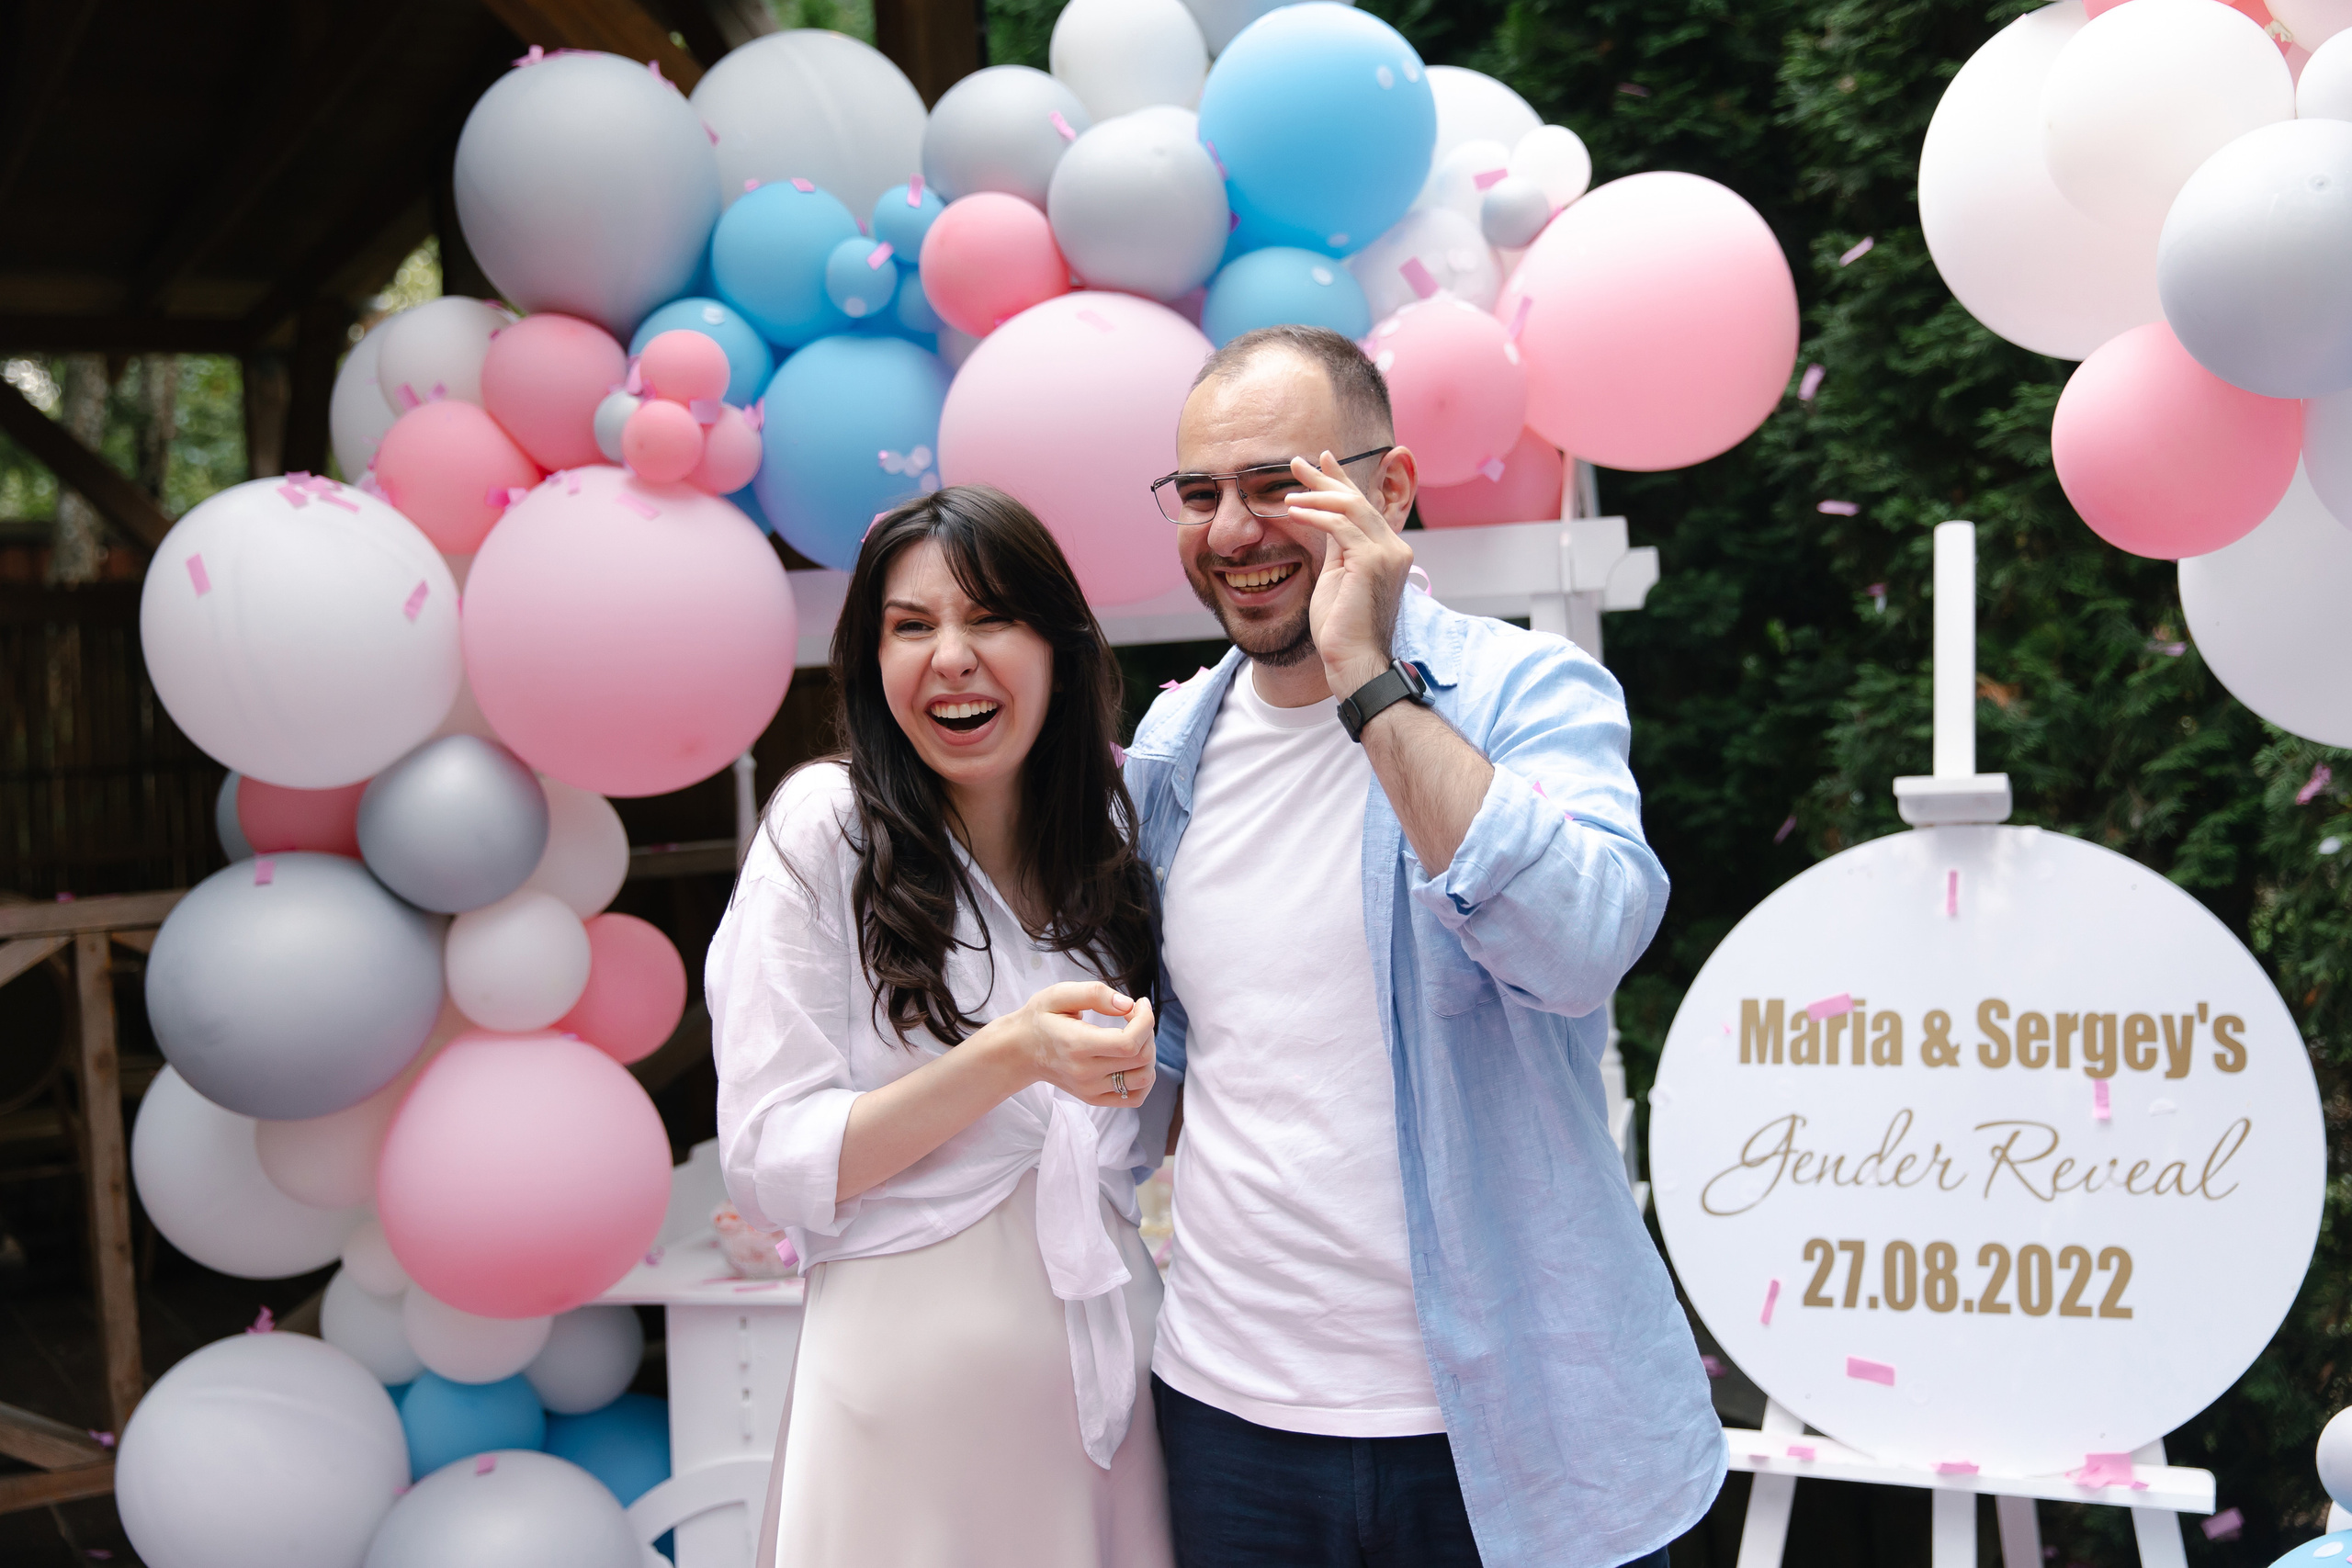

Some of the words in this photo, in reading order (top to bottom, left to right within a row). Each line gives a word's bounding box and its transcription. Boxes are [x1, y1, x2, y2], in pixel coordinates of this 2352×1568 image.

[1738, 998, 1904, 1067] Maria
[1920, 1009, 1961, 1068] &
[1976, 998, 2248, 1080] Sergey's
[1701, 1108, 1968, 1217] Gender
[1973, 1117, 2252, 1202] Reveal
[1802, 1237, 2134, 1320] 27.08.2022
